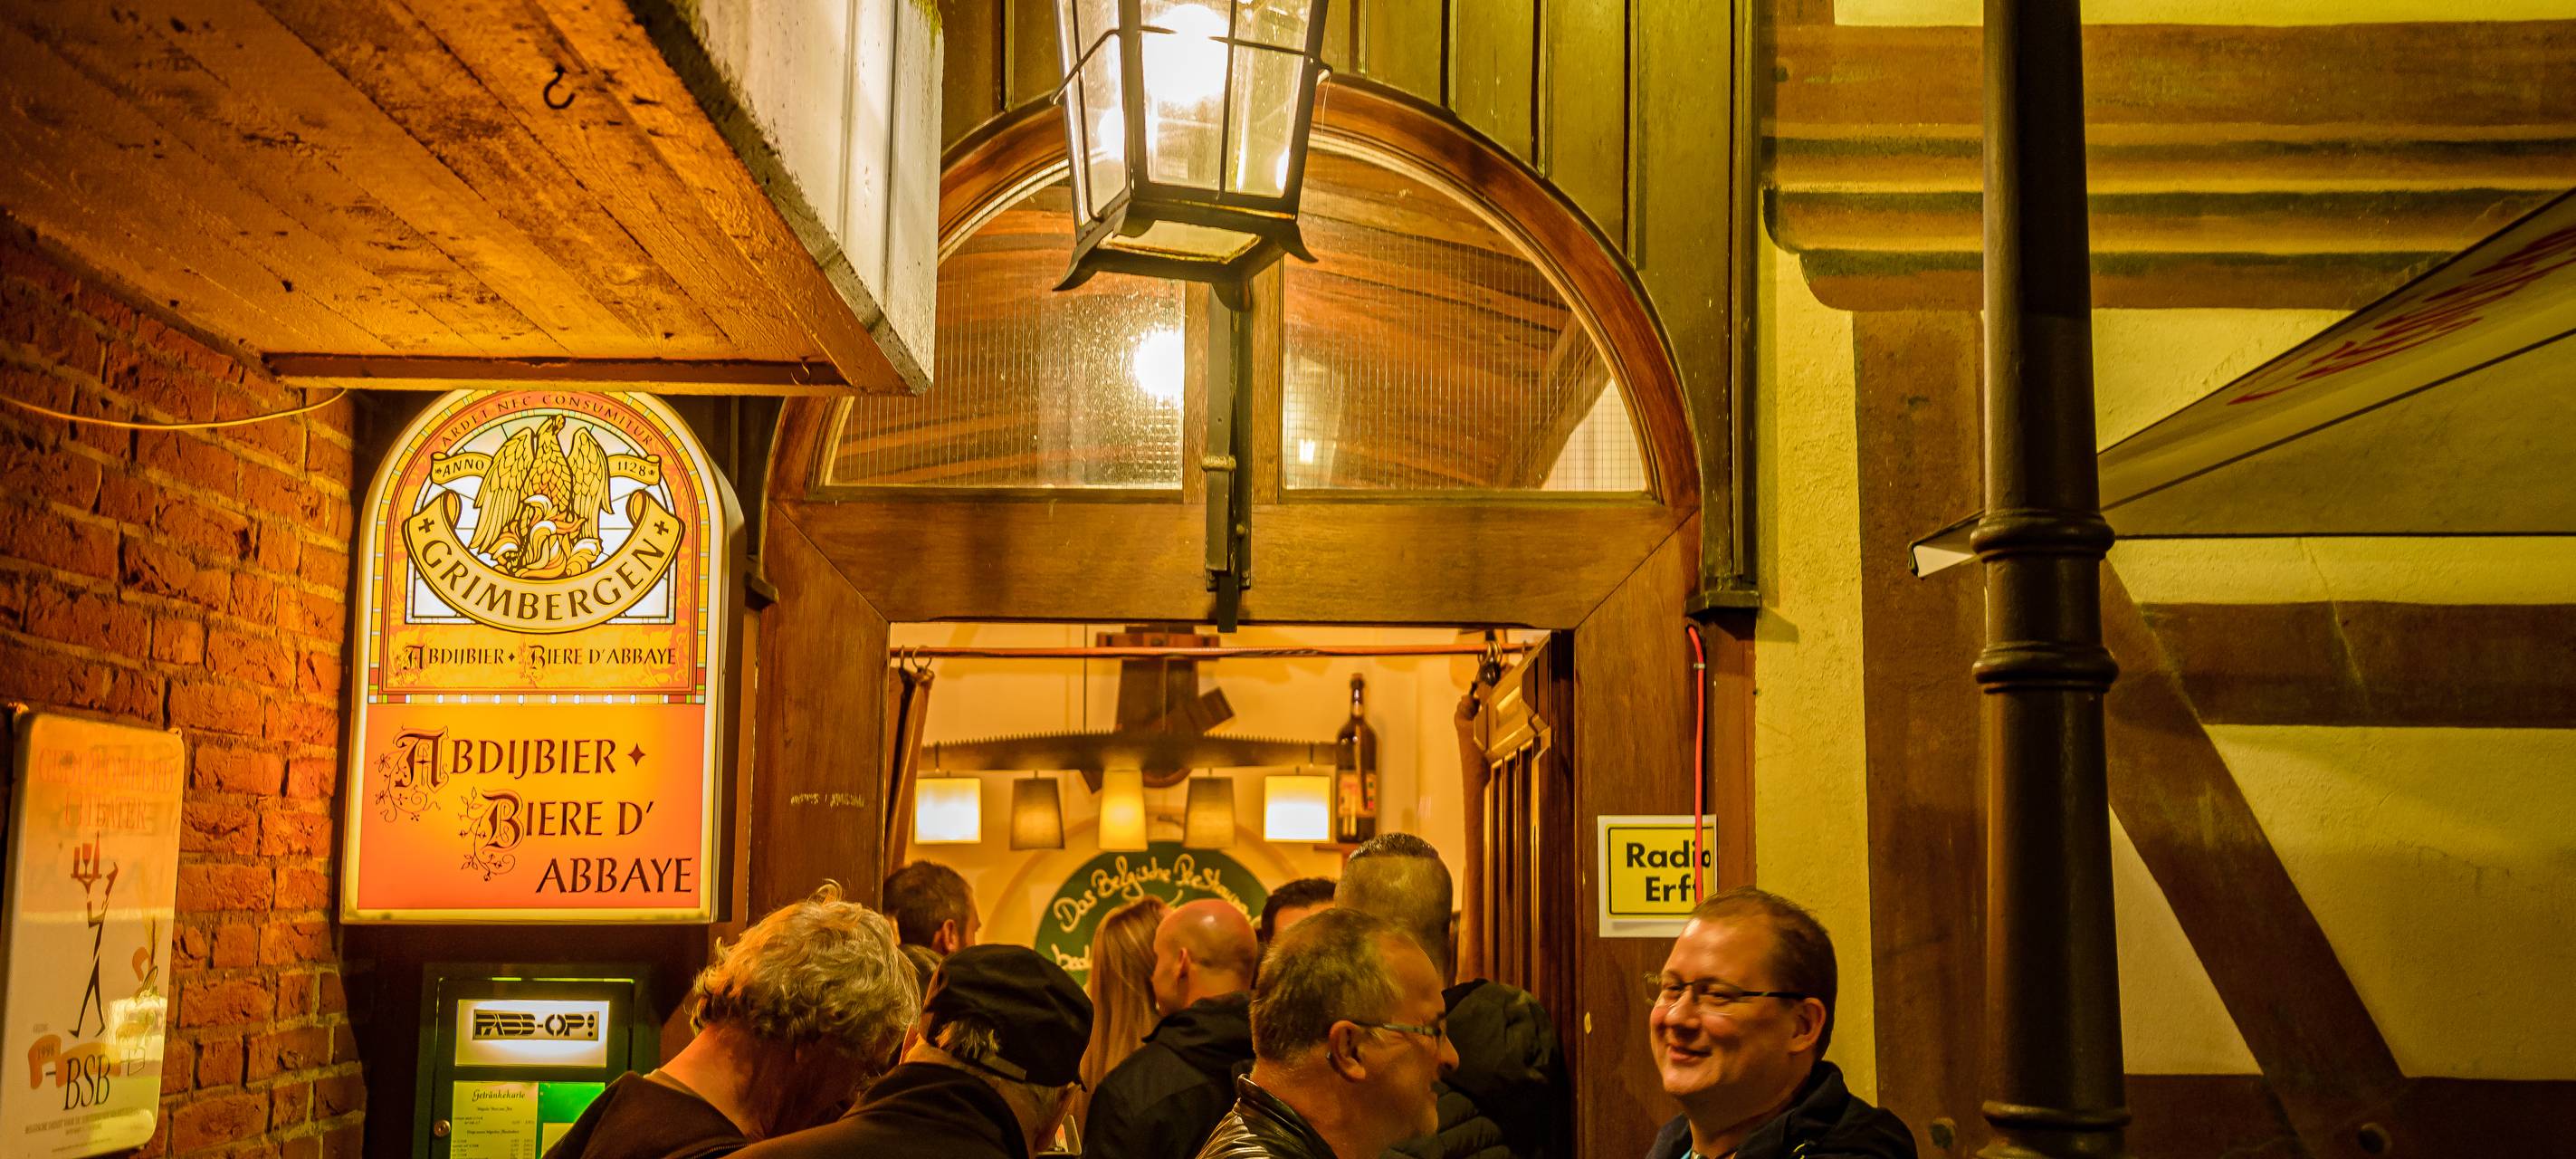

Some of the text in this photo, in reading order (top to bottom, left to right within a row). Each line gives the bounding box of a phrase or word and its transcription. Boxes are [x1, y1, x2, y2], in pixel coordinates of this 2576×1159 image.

[442, 395, 653, 447] ARDET NEC CONSUMITUR
[442, 459, 485, 478] ANNO
[616, 460, 647, 477] 1128
[422, 538, 670, 622] GRIMBERGEN
[589, 647, 676, 666] D'ABBAYE
[535, 857, 692, 895] ABBAYE
[1646, 874, 1697, 903] Erf
[1053, 888, 1098, 934] Das
[62, 1053, 111, 1112] BSB
[472, 1088, 526, 1102] Getränkekarte
